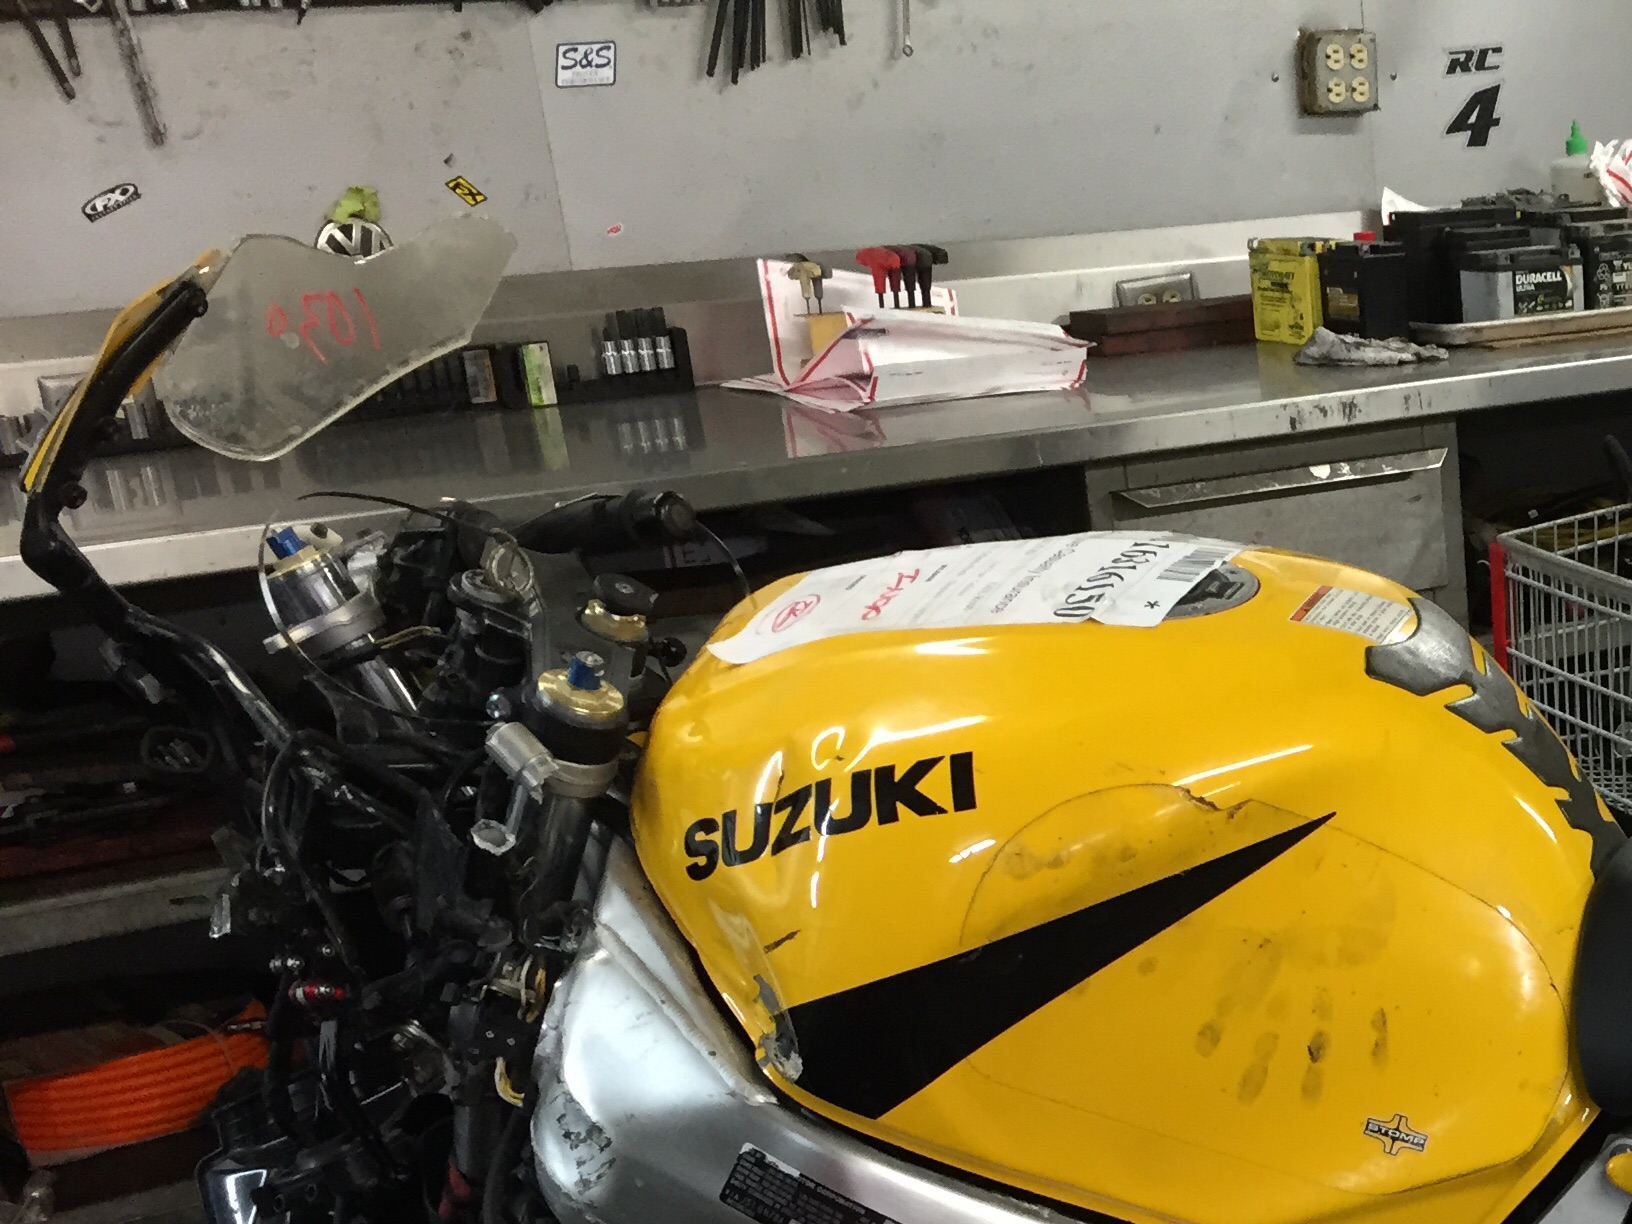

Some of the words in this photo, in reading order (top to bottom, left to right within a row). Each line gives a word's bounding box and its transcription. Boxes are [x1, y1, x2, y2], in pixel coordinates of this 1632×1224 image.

[561, 45, 611, 70] S&S
[1446, 47, 1502, 74] RC
[1446, 84, 1501, 147] 4
[1515, 270, 1562, 285] DURACELL
[684, 752, 977, 881] SUZUKI
[1367, 1123, 1425, 1145] STOMP
